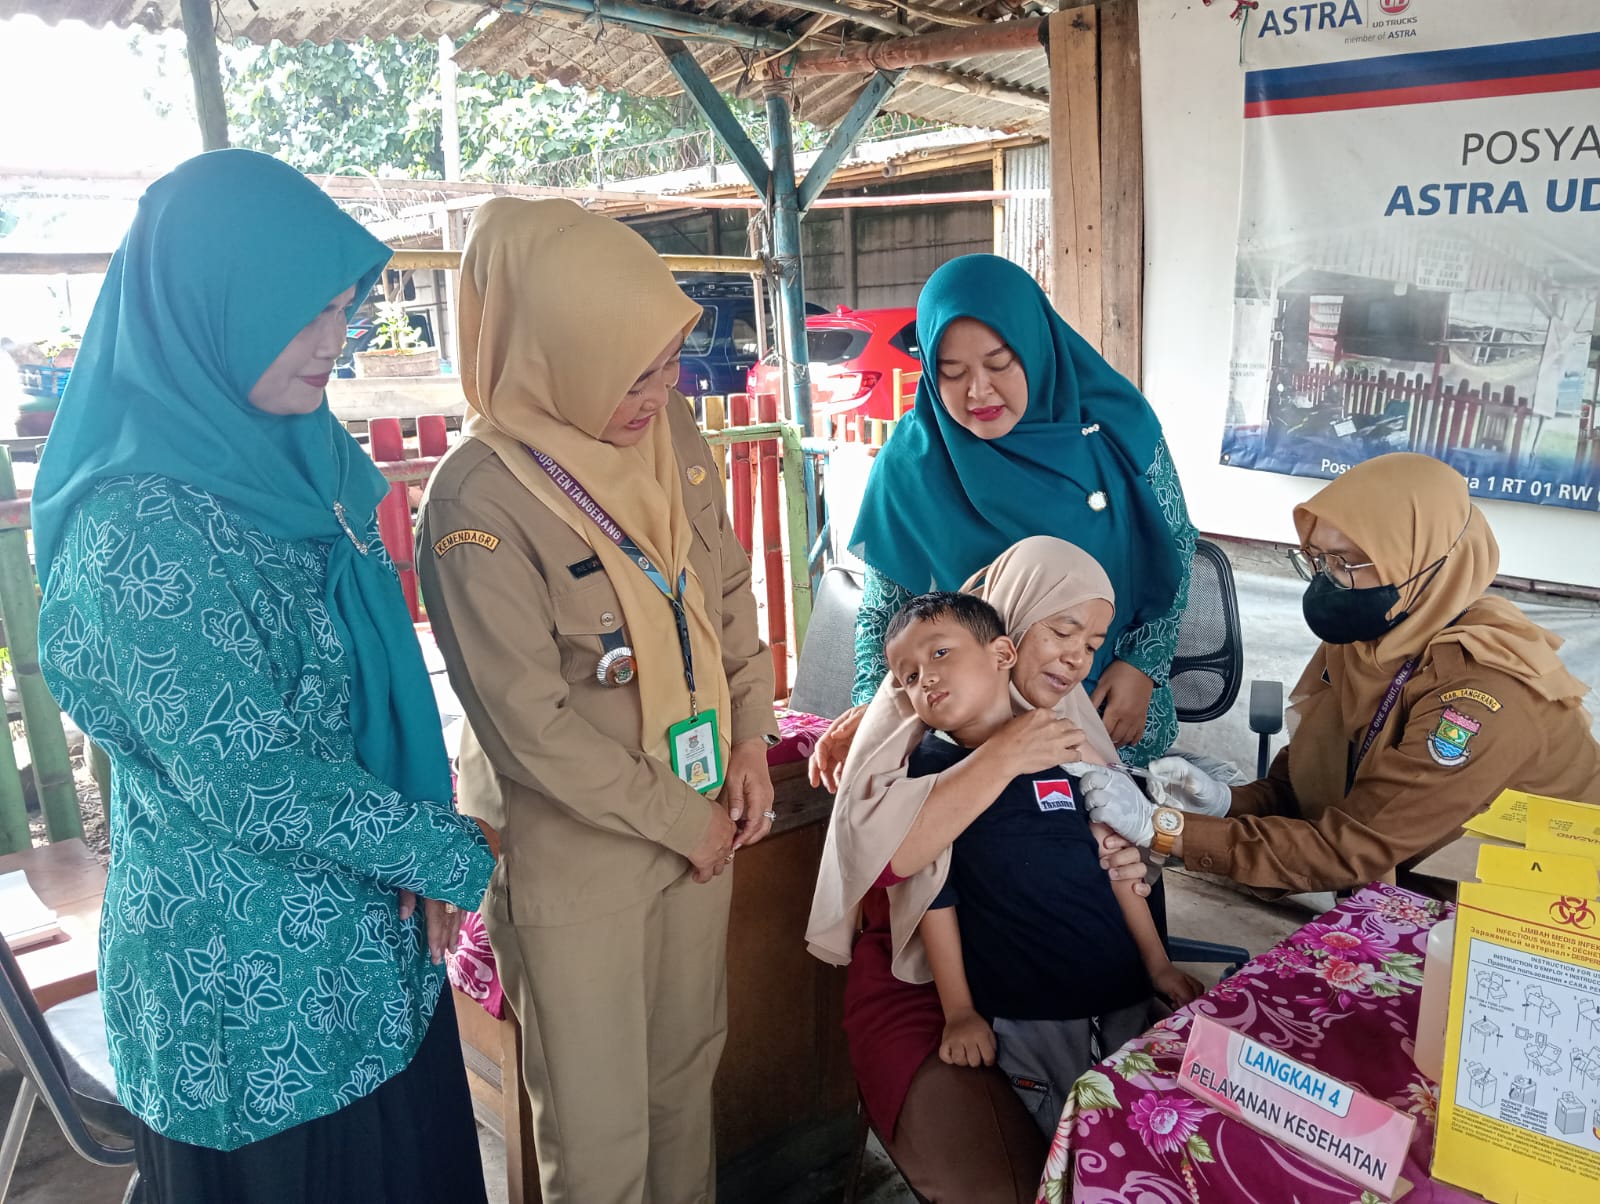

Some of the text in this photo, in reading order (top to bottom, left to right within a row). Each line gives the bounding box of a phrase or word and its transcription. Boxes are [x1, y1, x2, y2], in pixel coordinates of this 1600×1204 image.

[1258, 0, 1362, 38] ASTRA
[1386, 16, 1418, 26] TRUCKS
[1344, 29, 1416, 44] member of ASTRA
[1384, 181, 1528, 216] ASTRA
[1487, 476, 1496, 491] 1
[1502, 477, 1526, 494] RT
[1530, 480, 1552, 497] 01
[1559, 484, 1593, 502] RW
[569, 484, 622, 540] TANGERANG
[437, 532, 496, 553] KEMENDAGRI
[1373, 711, 1385, 728] ONE
[1382, 687, 1400, 712] SPIRIT,
[1395, 670, 1408, 686] ONE
[1461, 690, 1498, 708] TANGERANG
[1496, 927, 1539, 943] INFECTIOUS
[1540, 939, 1566, 950] WASTE
[1520, 926, 1550, 938] LIMBAH
[1551, 934, 1576, 945] MEDIS
[1493, 953, 1533, 969] INSTRUCTION
[1531, 957, 1575, 973] INSTRUCTION
[1577, 968, 1591, 977] FOR
[1569, 980, 1588, 990] CARA
[1245, 1046, 1341, 1108] LANGKAH 4
[1190, 1062, 1281, 1123] PELAYANAN
[1284, 1111, 1387, 1180] KESEHATAN
